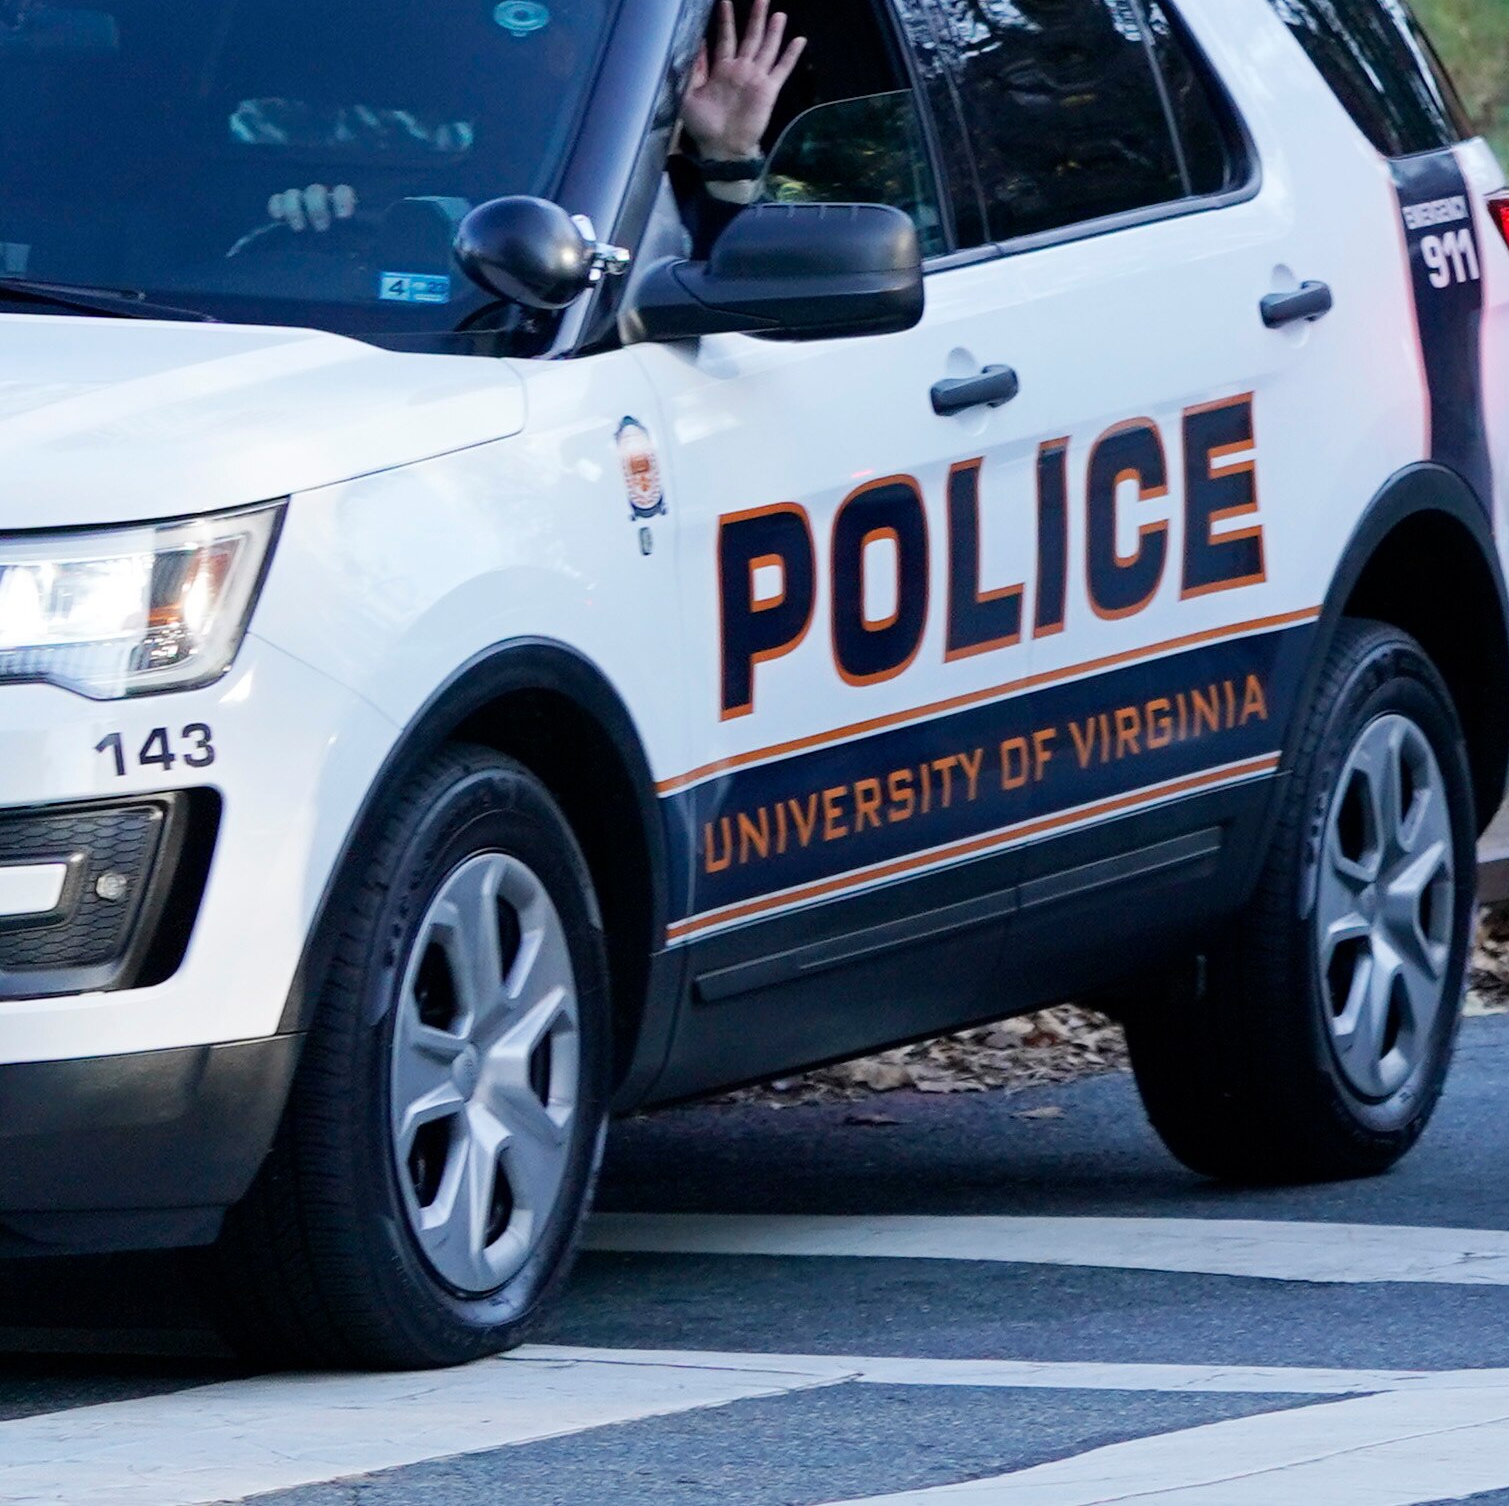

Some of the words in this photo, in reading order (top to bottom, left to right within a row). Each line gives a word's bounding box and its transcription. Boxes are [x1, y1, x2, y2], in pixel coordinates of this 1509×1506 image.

[1420, 228, 1480, 288] 911
[716, 390, 1267, 722] POLICE
[94, 722, 216, 776] 143
[704, 747, 983, 874] UNIVERSITY
[1000, 727, 1057, 791] OF
[1068, 673, 1268, 770] VIRGINIA
